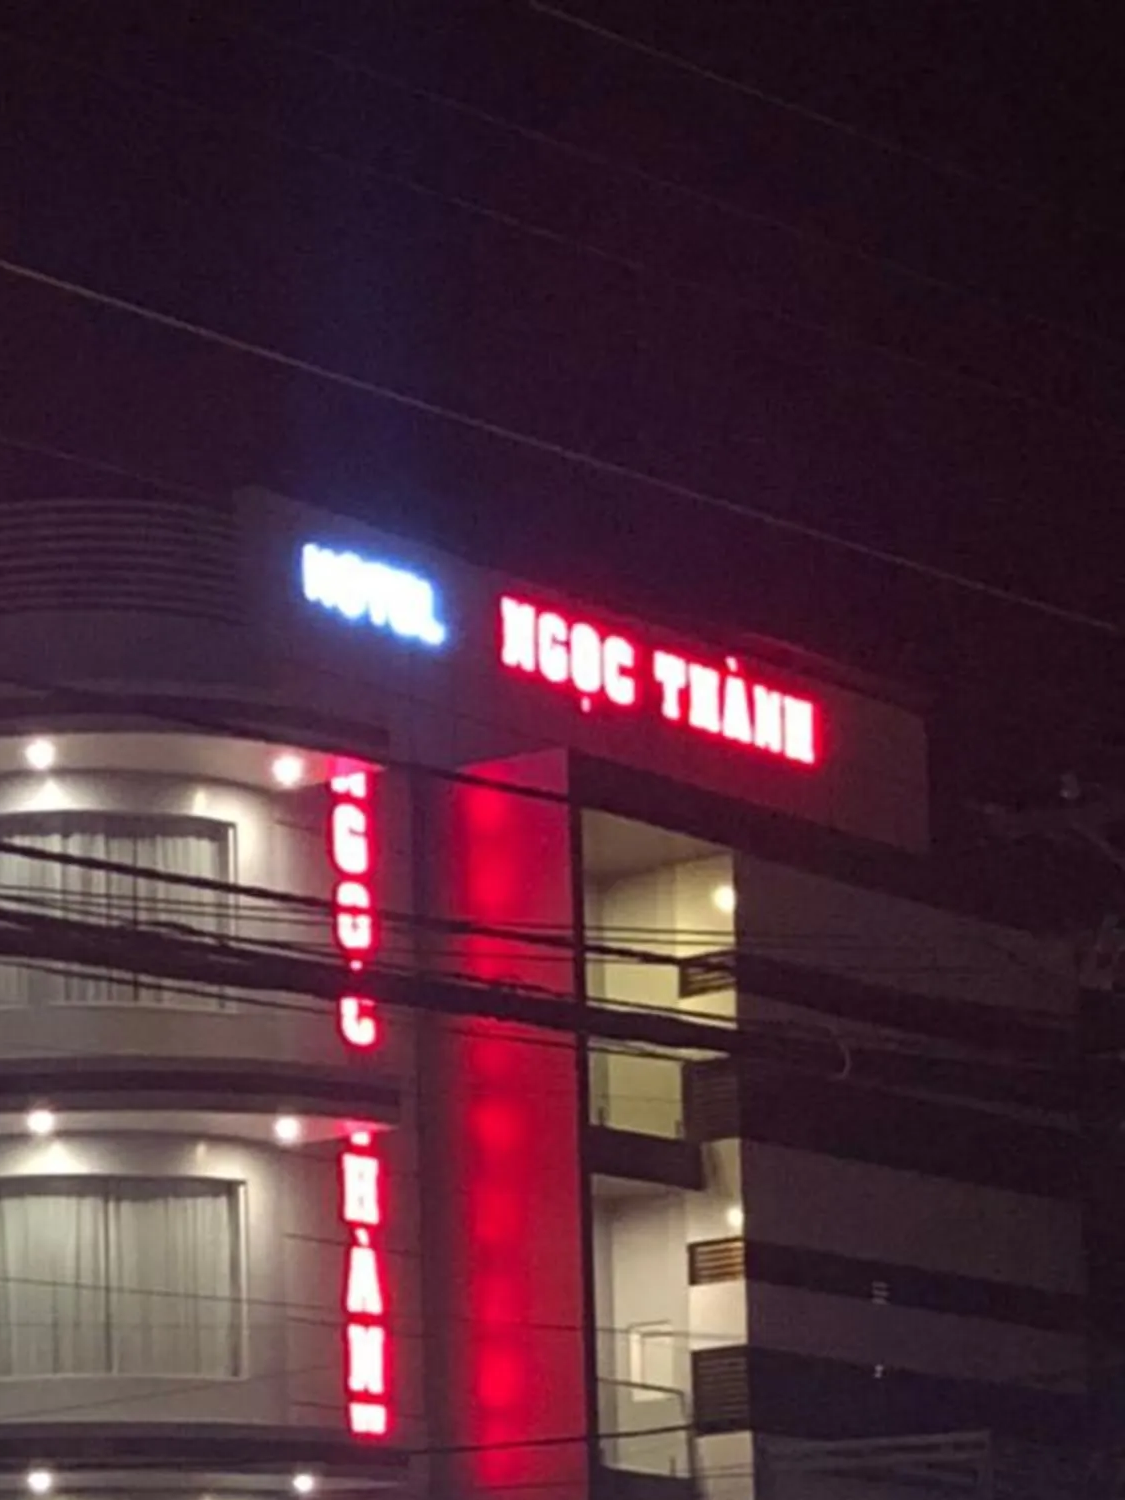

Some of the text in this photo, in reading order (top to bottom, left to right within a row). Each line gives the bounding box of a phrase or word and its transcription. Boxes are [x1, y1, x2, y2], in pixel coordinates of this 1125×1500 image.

[500, 596, 636, 713] NGỌC
[653, 651, 816, 764] THÀNH
[342, 1131, 388, 1435] HÀN
